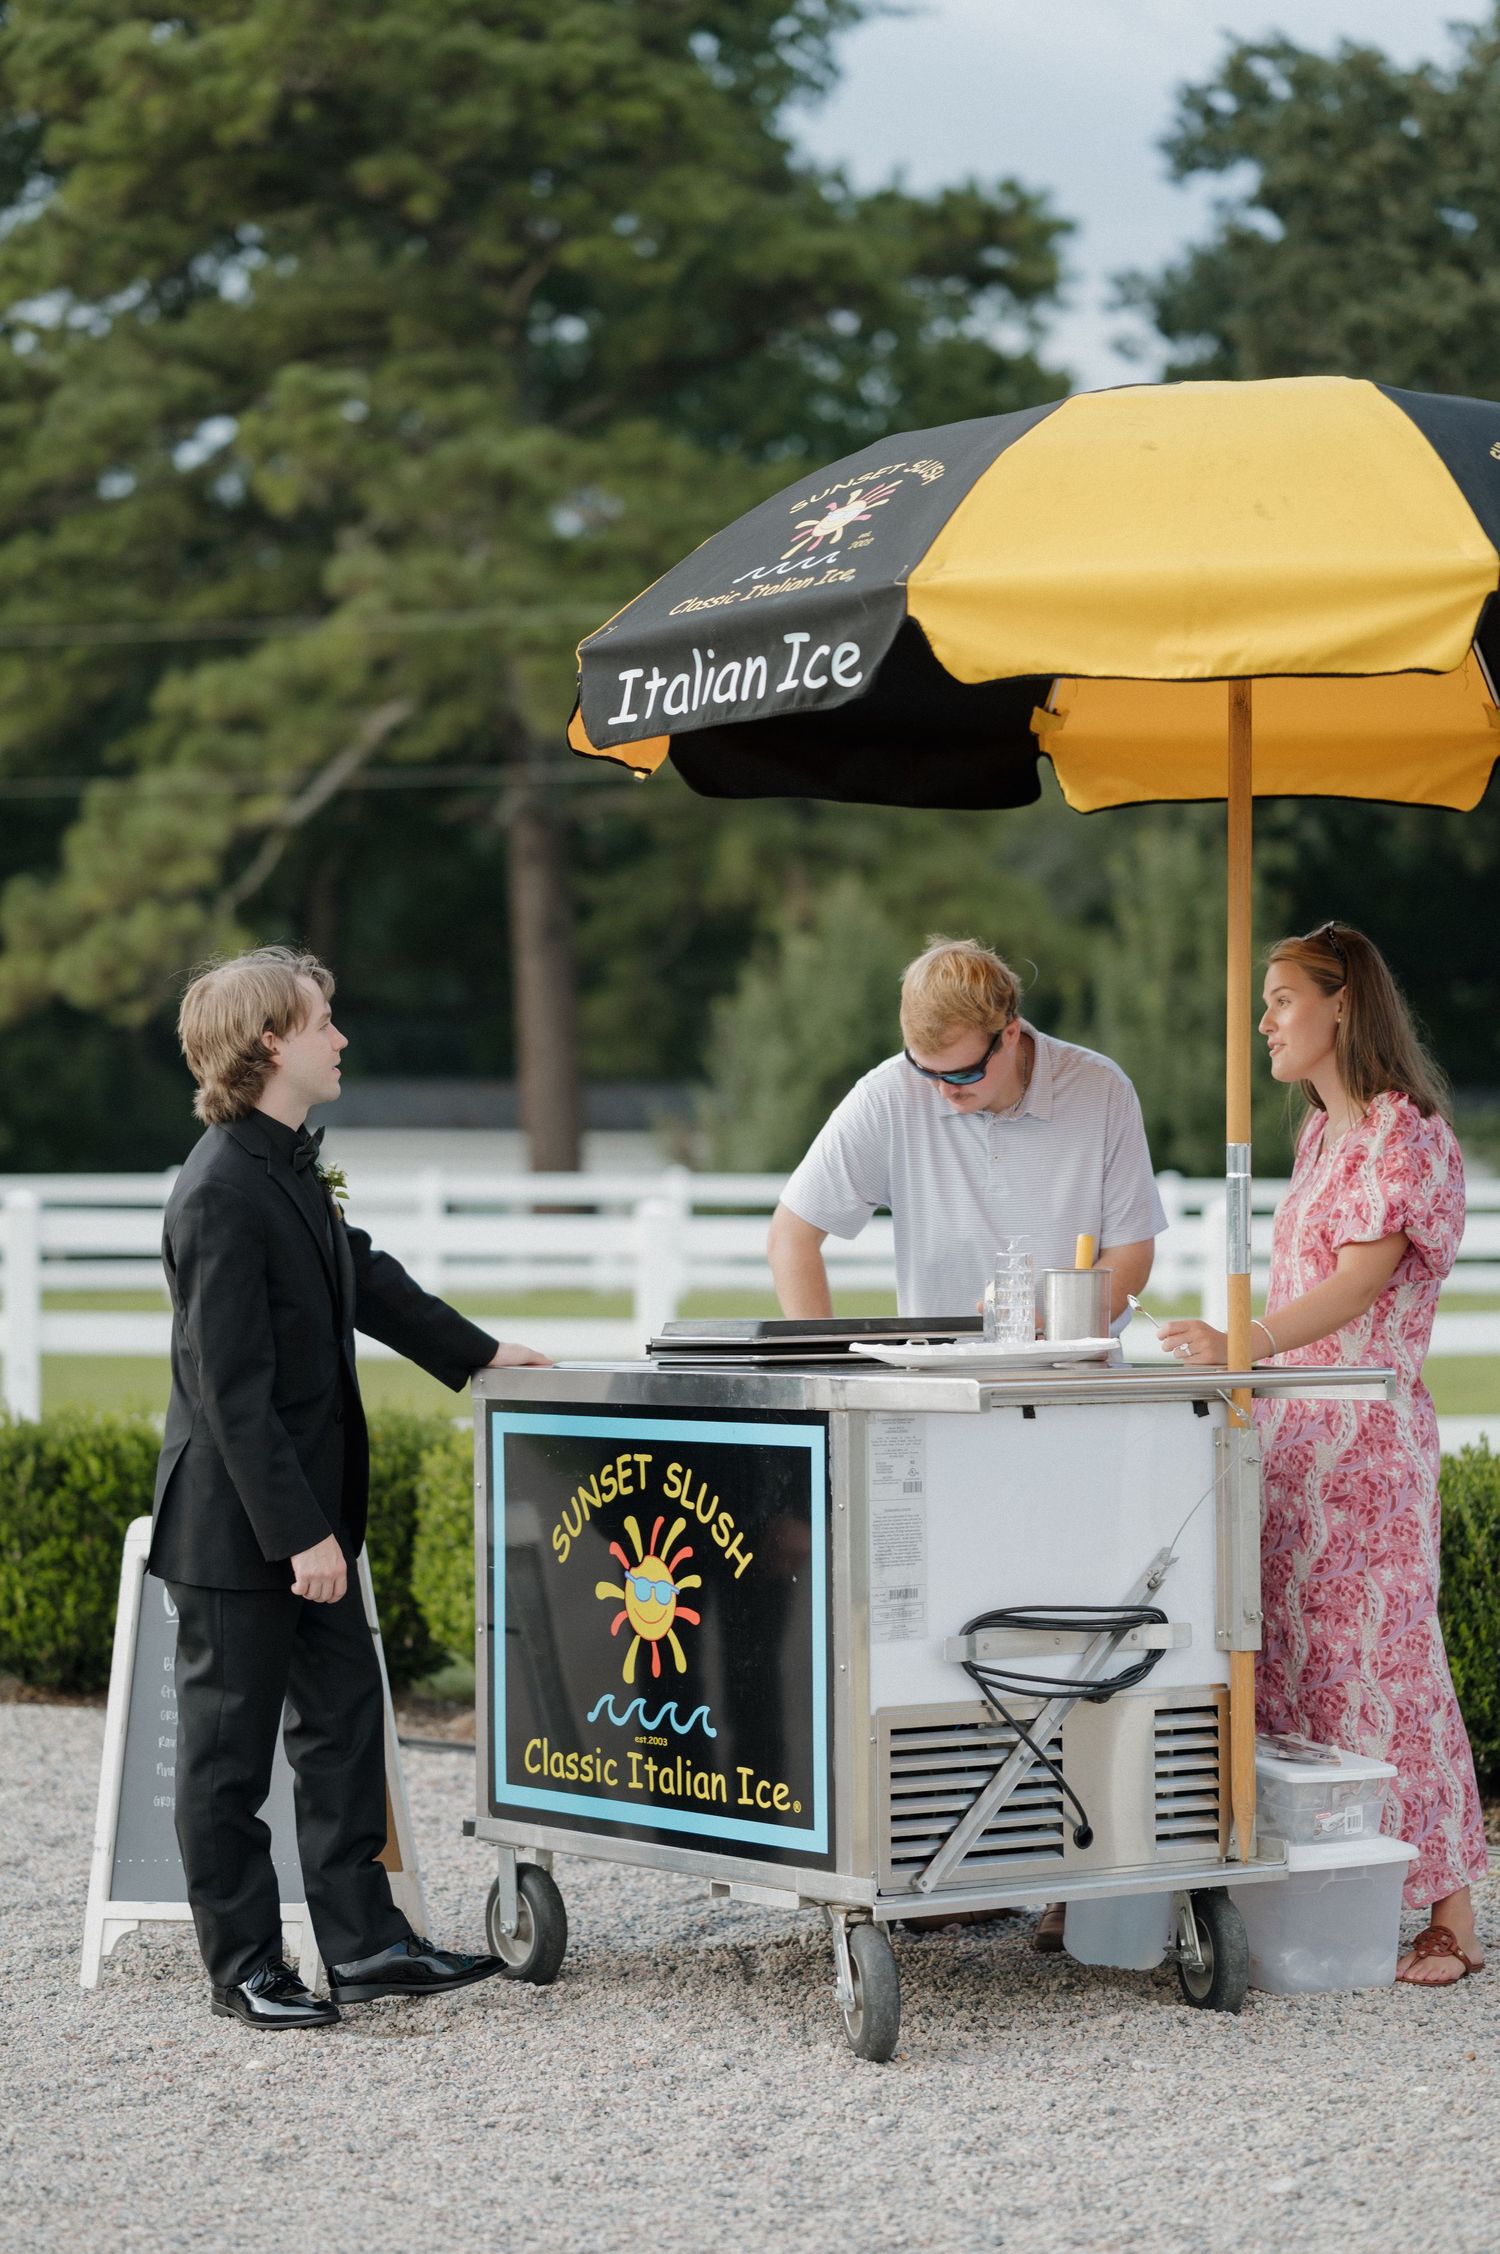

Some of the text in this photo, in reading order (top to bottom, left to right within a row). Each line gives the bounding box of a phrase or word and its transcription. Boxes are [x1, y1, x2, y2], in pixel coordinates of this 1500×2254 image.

[789, 458, 946, 515] SUNSET SLUSH
[668, 590, 742, 616] Classic
[739, 576, 816, 602] Italian
[607, 632, 864, 726] Italian Ice
[552, 1453, 653, 1563] SUNSET
[663, 1462, 753, 1579] SLUSH
[524, 1738, 618, 1787] Classic
[627, 1751, 728, 1804] Italian
